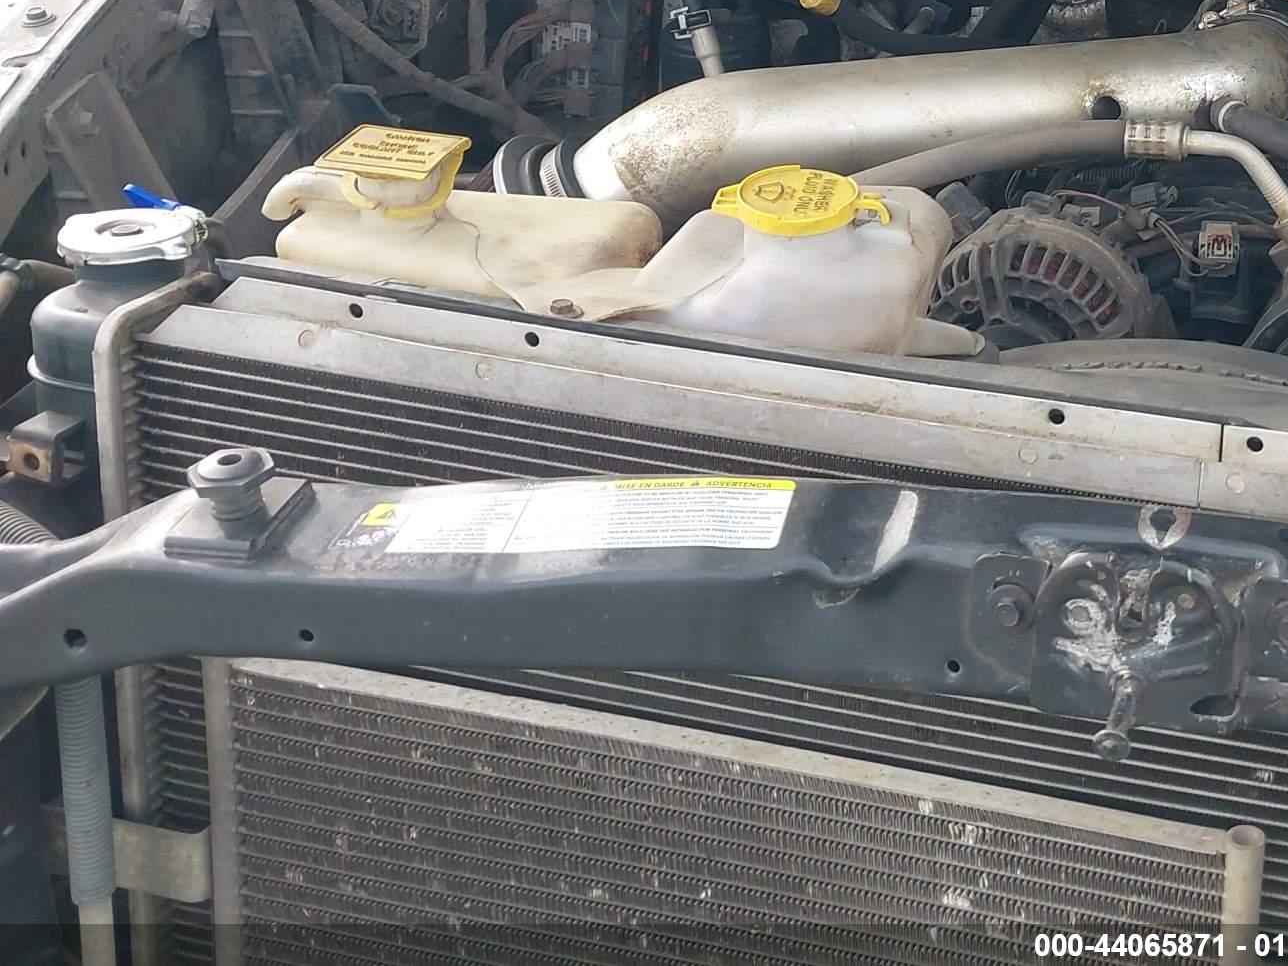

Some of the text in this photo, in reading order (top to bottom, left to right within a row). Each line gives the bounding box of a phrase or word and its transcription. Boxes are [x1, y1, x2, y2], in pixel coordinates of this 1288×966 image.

[801, 172, 822, 194] FLUID
[812, 178, 840, 212] WASHER
[638, 481, 650, 489] EN
[653, 481, 685, 489] GARDE
[705, 480, 773, 489] ADVERTENCIA
